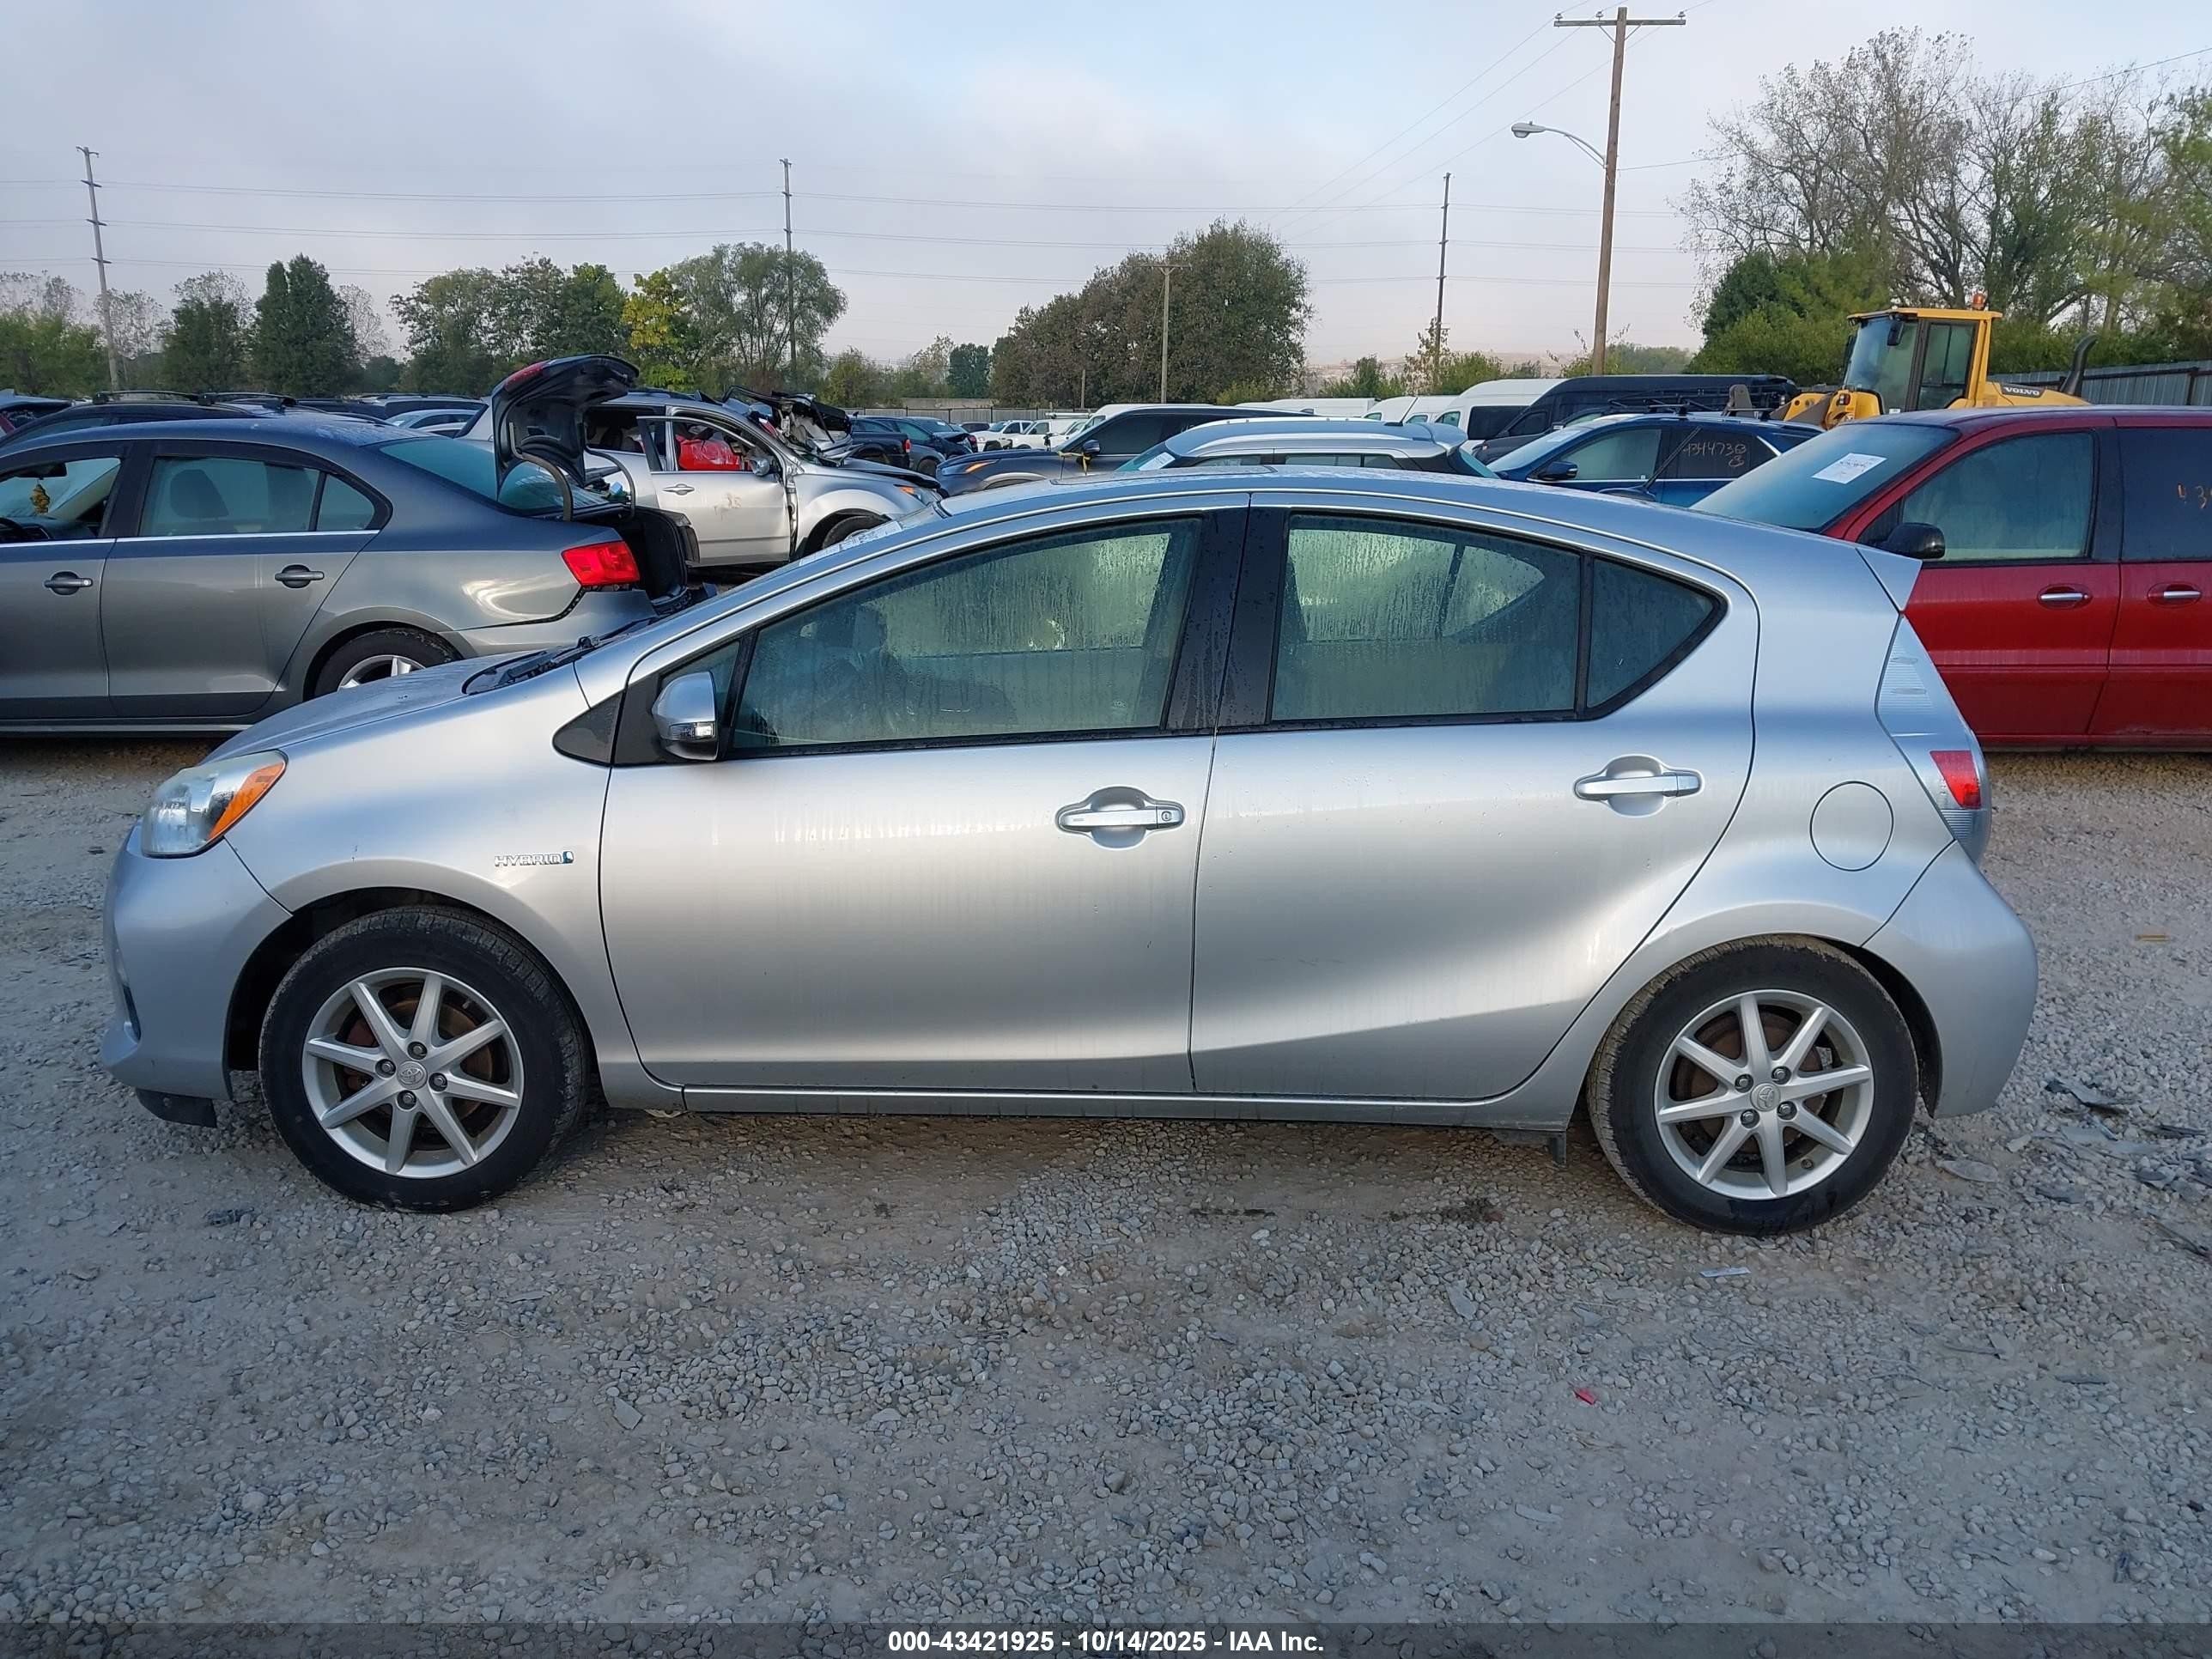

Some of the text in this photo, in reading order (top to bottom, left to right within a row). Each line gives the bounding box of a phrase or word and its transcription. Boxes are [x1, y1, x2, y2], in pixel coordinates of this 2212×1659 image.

[2004, 386, 2040, 396] VOLVO
[2178, 483, 2212, 509] 43
[495, 853, 563, 866] HYBRID
